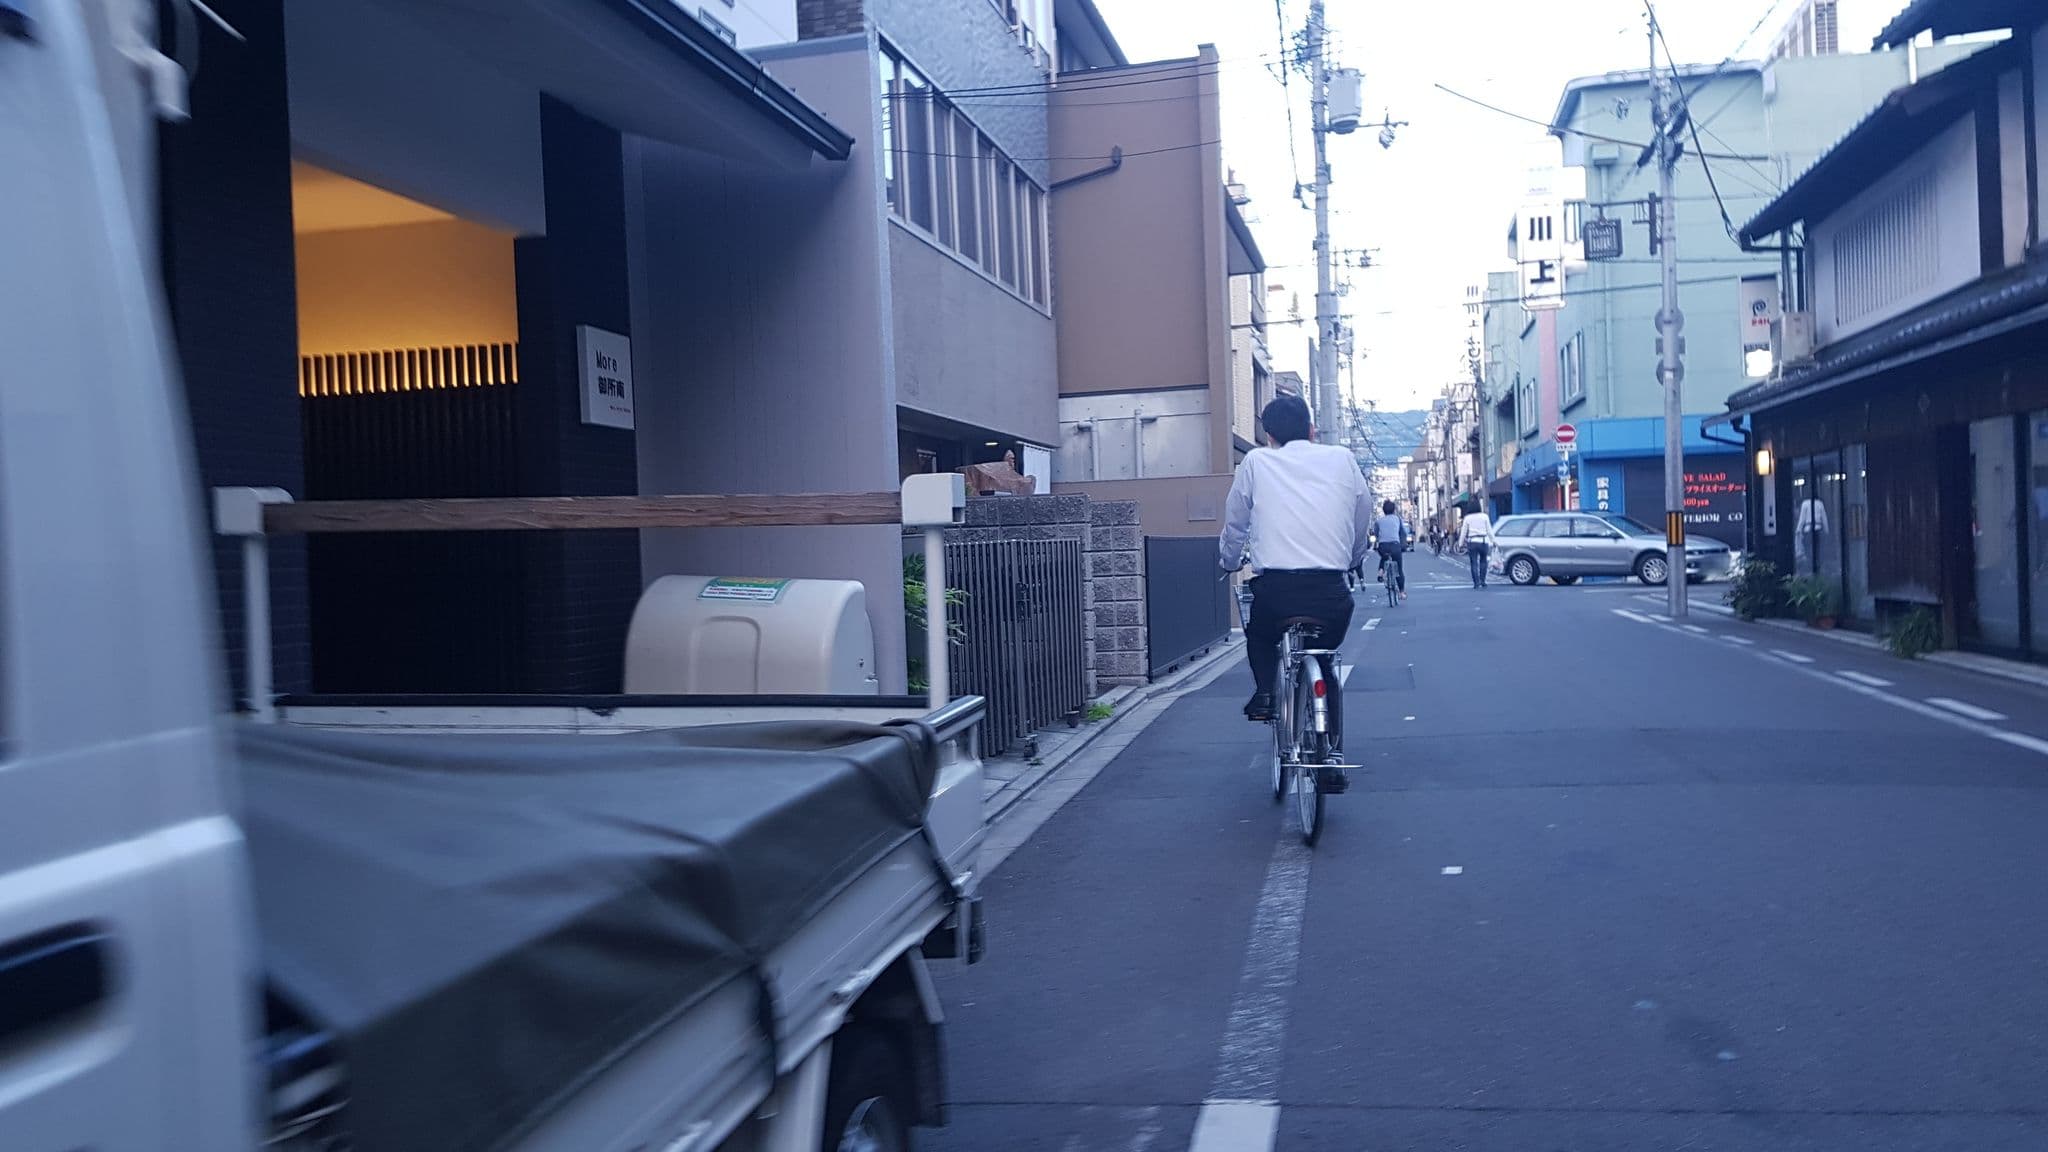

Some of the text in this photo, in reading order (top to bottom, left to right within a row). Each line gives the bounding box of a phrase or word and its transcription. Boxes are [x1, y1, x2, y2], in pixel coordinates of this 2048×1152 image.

[595, 350, 618, 373] More
[1698, 472, 1726, 481] SALAD
[1684, 483, 1746, 493] プライスオーダー
[1684, 513, 1720, 523] TERIOR
